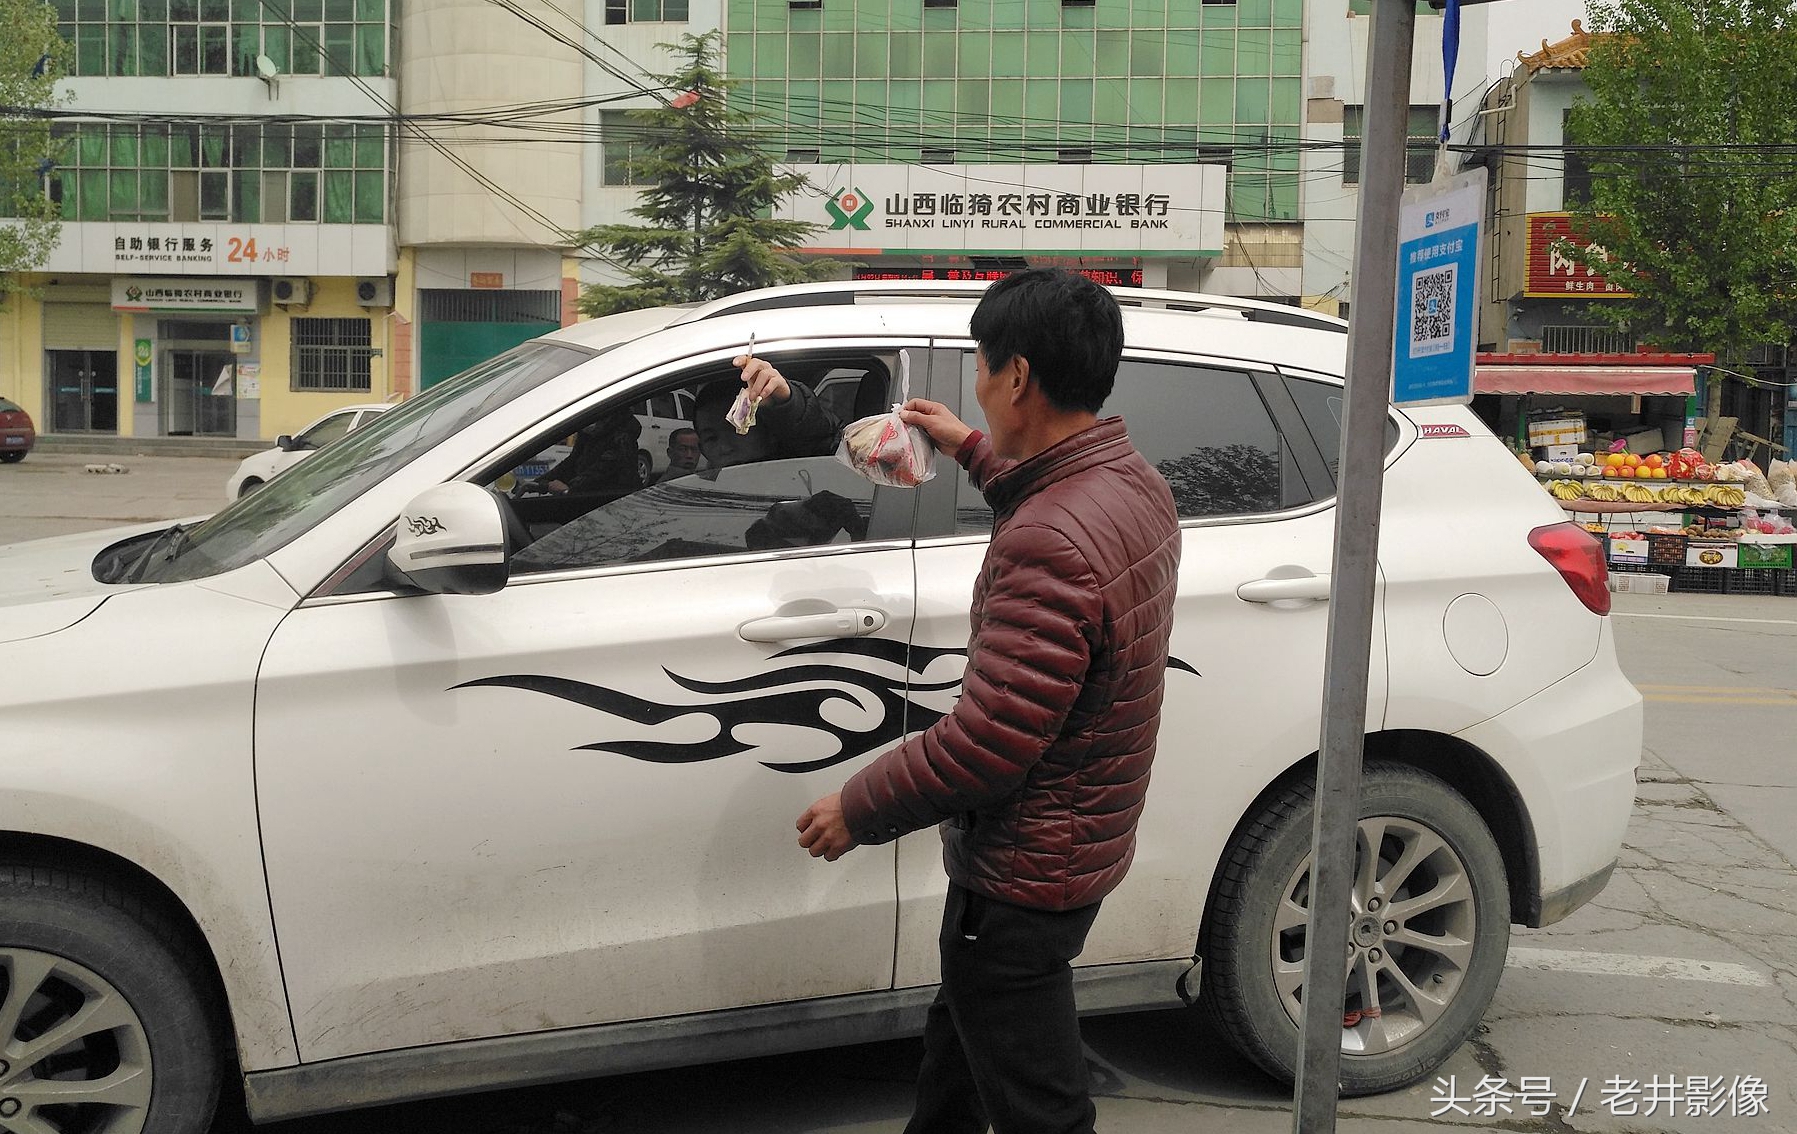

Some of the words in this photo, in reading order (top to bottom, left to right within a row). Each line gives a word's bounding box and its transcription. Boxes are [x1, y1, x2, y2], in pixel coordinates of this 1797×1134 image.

[885, 193, 1170, 216] 山西临猗农村商业银行
[885, 218, 935, 229] SHANXI
[942, 218, 974, 229] LINYI
[981, 218, 1027, 229] RURAL
[1034, 218, 1122, 229] COMMERCIAL
[1130, 218, 1169, 229] BANK
[115, 236, 213, 253] 自助银行服务
[227, 237, 258, 263] 24
[263, 247, 290, 263] 小时
[115, 254, 172, 262] SELF-SERVICE
[176, 254, 212, 262] BANKING
[1565, 281, 1595, 291] 鲜生肉
[1424, 426, 1464, 434] HAVAL
